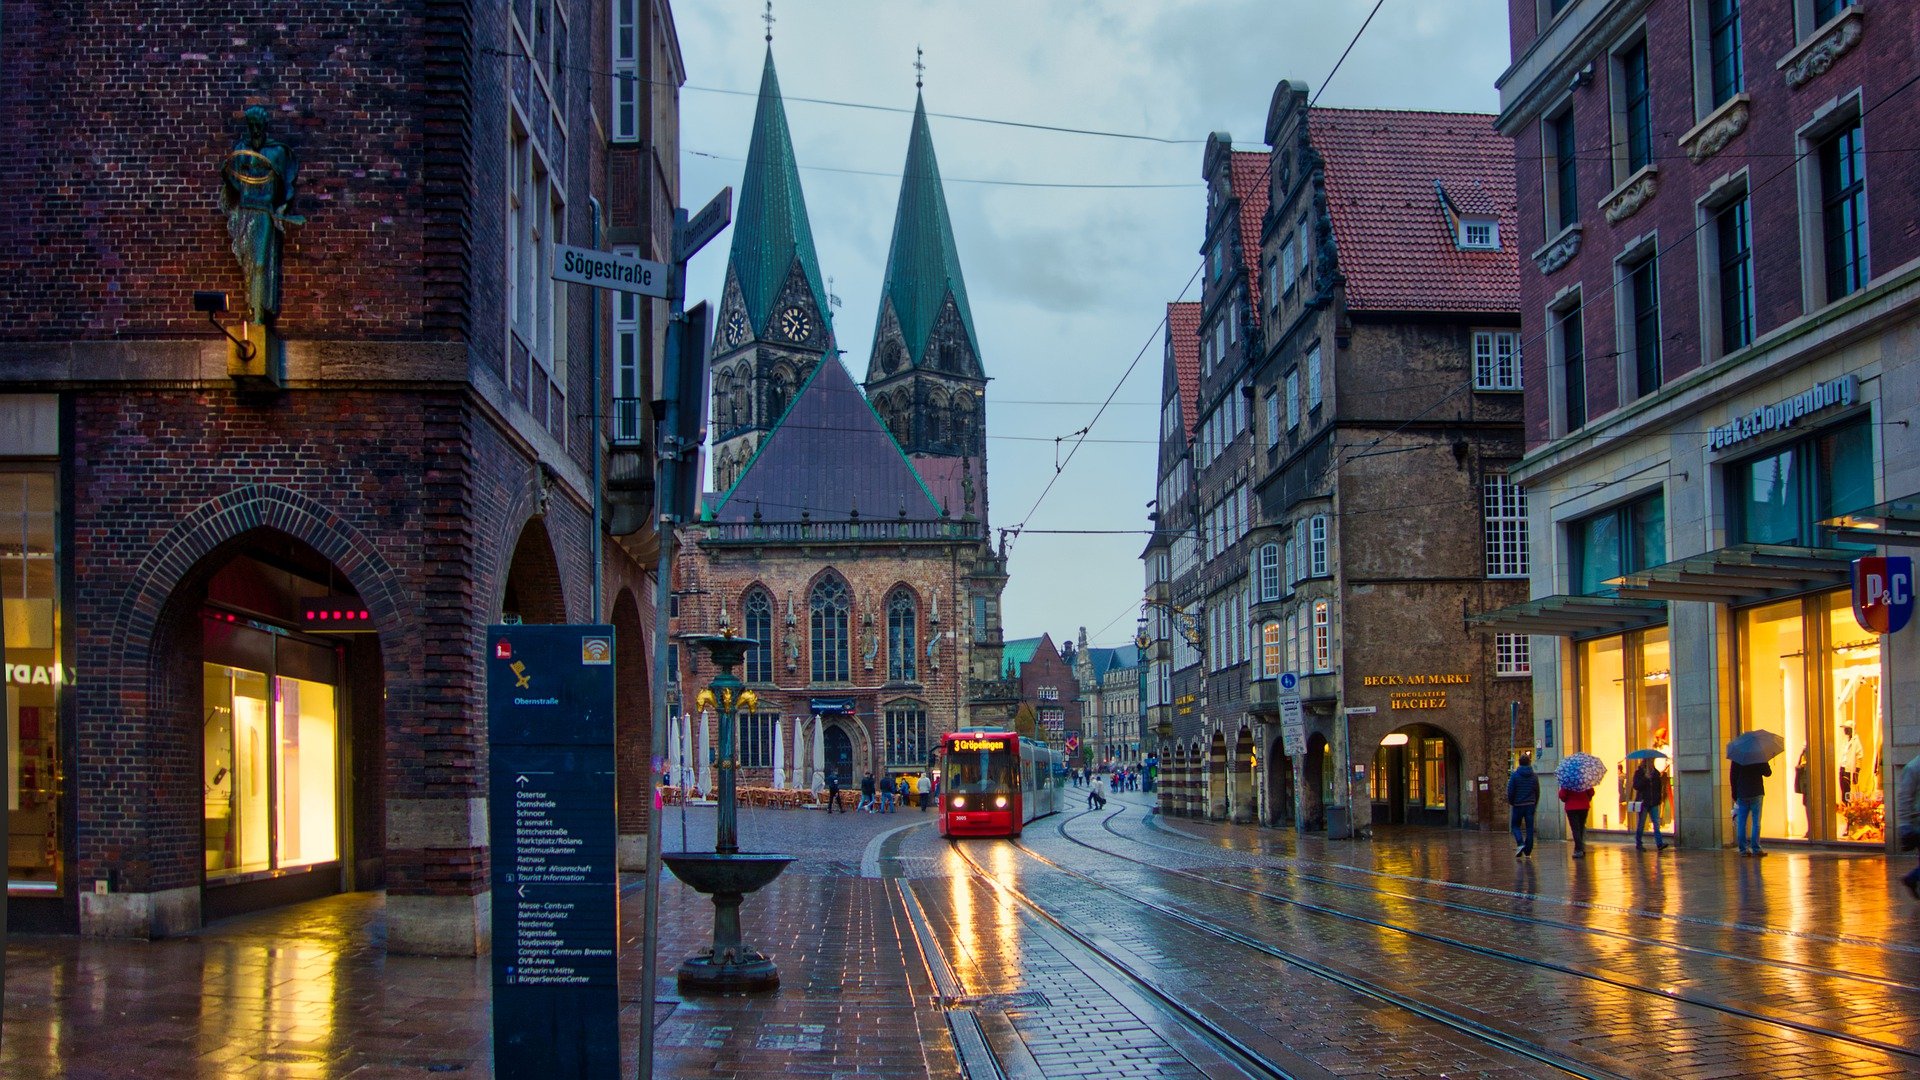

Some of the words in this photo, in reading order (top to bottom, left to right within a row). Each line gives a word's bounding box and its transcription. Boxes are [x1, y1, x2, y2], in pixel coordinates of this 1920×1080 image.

[564, 251, 652, 286] Sögestraße
[1867, 573, 1908, 606] P&C
[1406, 674, 1425, 686] AM
[1428, 673, 1472, 684] MARKT
[514, 697, 559, 705] Obernstraße
[1391, 698, 1447, 710] HACHEZ
[954, 740, 960, 752] 3
[960, 740, 1004, 751] Gröpelingen
[516, 791, 547, 799] Ostertor
[516, 828, 568, 836] Böttcherstraße
[517, 873, 541, 881] Tourist
[543, 873, 585, 882] Information
[518, 911, 569, 919] Bahnhofsplatz
[518, 920, 555, 928] Herdentor
[518, 939, 564, 948] Lloydpassage
[518, 948, 550, 957] Congress
[551, 948, 582, 956] Centrum
[584, 948, 612, 956] Bremen
